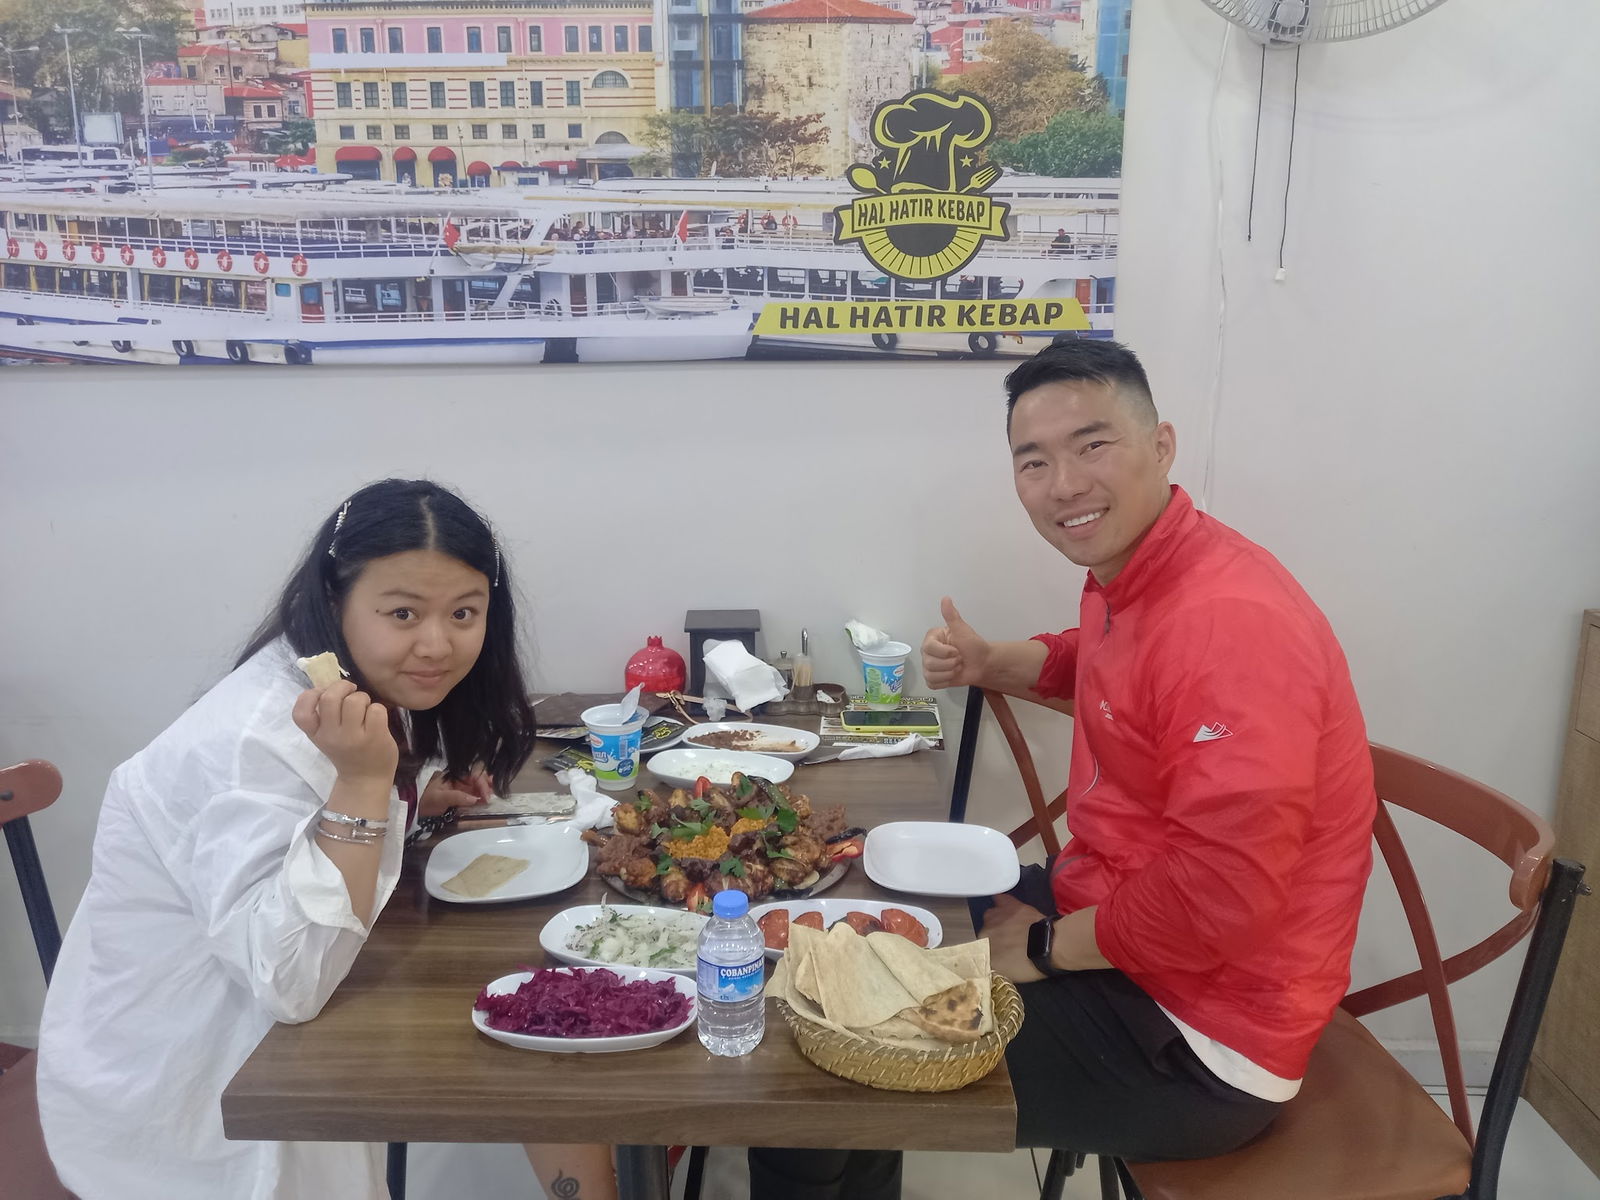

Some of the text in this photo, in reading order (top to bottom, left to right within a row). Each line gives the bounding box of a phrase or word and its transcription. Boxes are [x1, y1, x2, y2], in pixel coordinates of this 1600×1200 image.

[857, 198, 986, 227] HAL HATIR KEBAP
[779, 302, 1064, 329] HAL HATIR KEBAP
